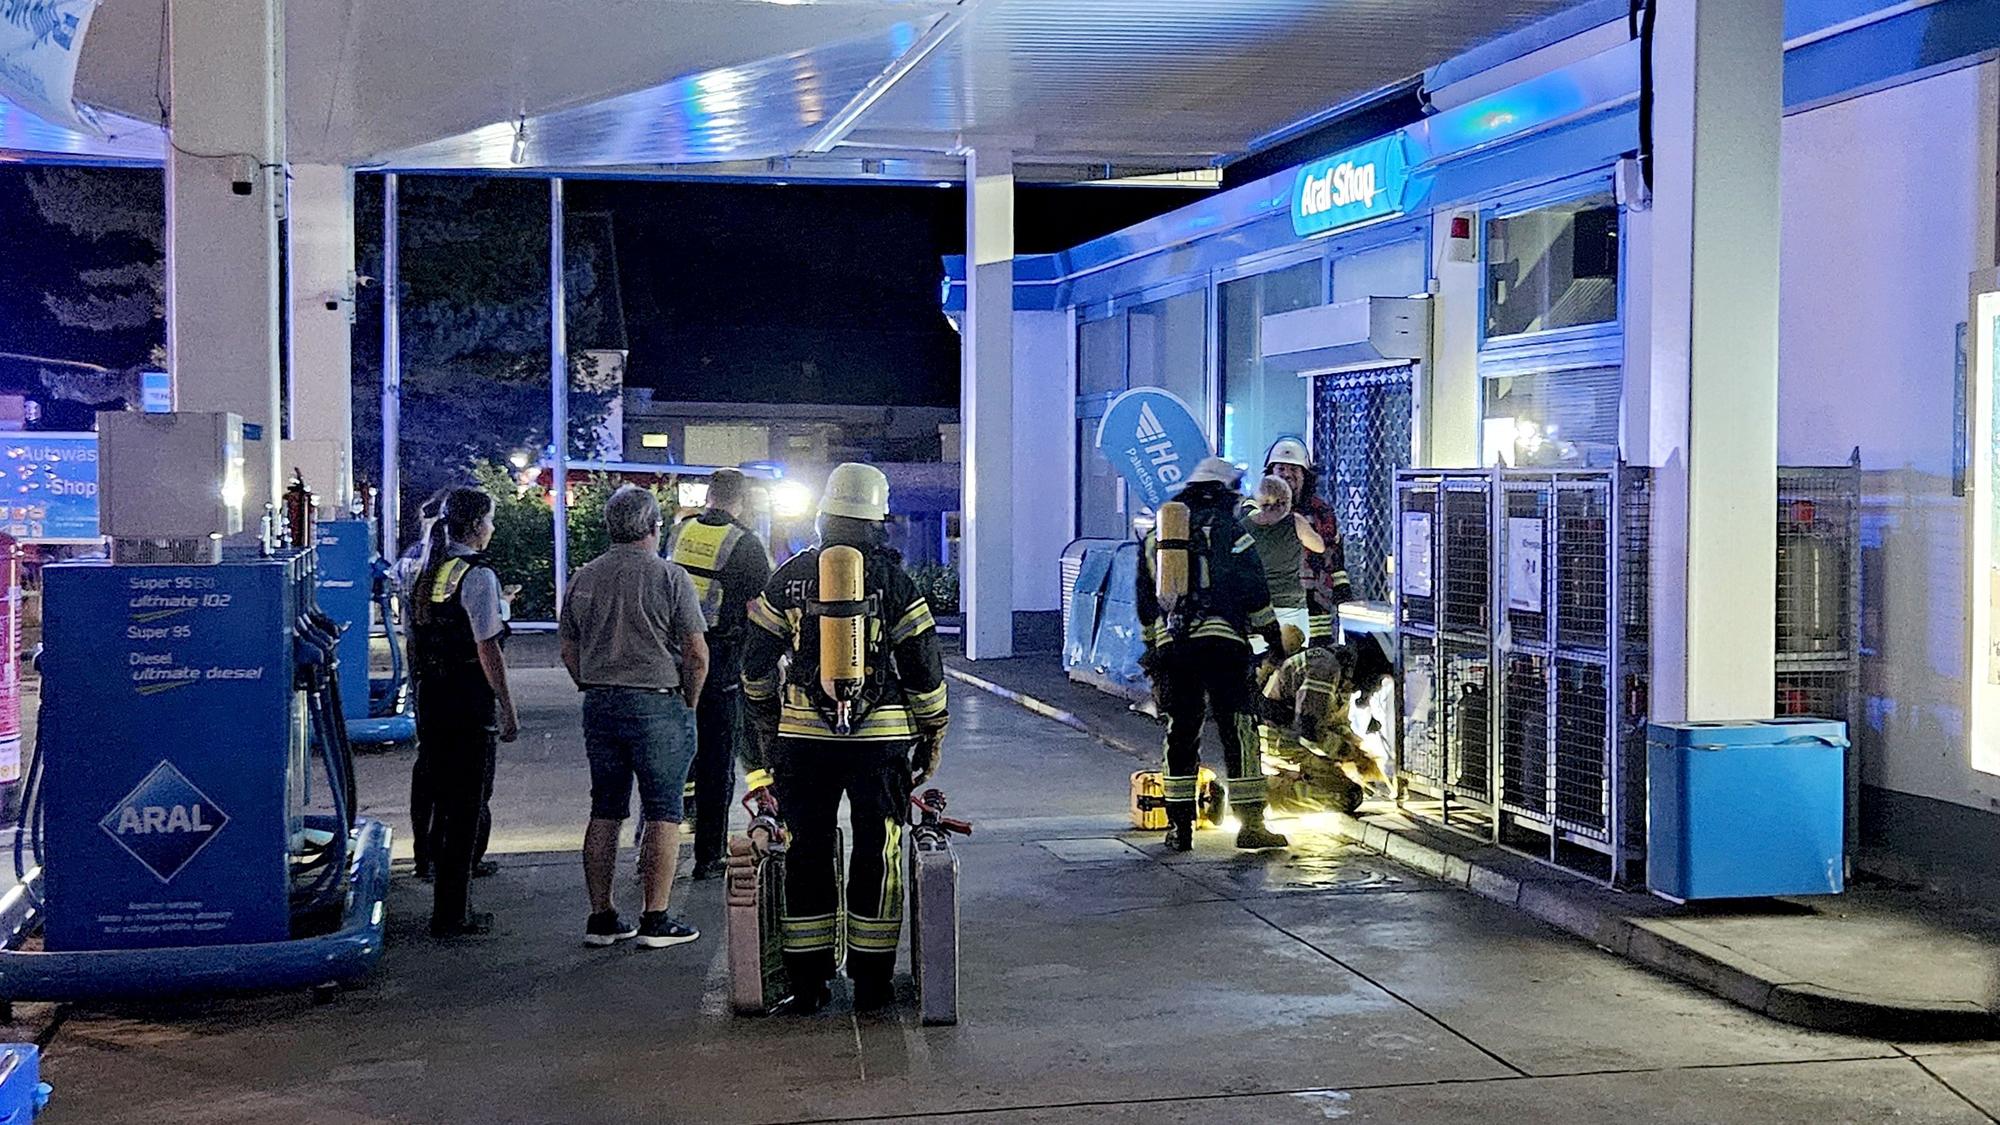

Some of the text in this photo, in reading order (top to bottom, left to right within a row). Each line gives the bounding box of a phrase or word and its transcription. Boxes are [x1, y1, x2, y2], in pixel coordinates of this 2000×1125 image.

[1301, 160, 1375, 217] Aral Shop
[51, 479, 97, 499] Shop
[129, 576, 173, 591] Super
[175, 576, 192, 589] 95
[129, 593, 232, 608] ultimate 102
[126, 624, 191, 641] Super 95
[129, 651, 173, 665] Diesel
[132, 665, 263, 681] ultimate diesel
[117, 803, 213, 835] ARAL
